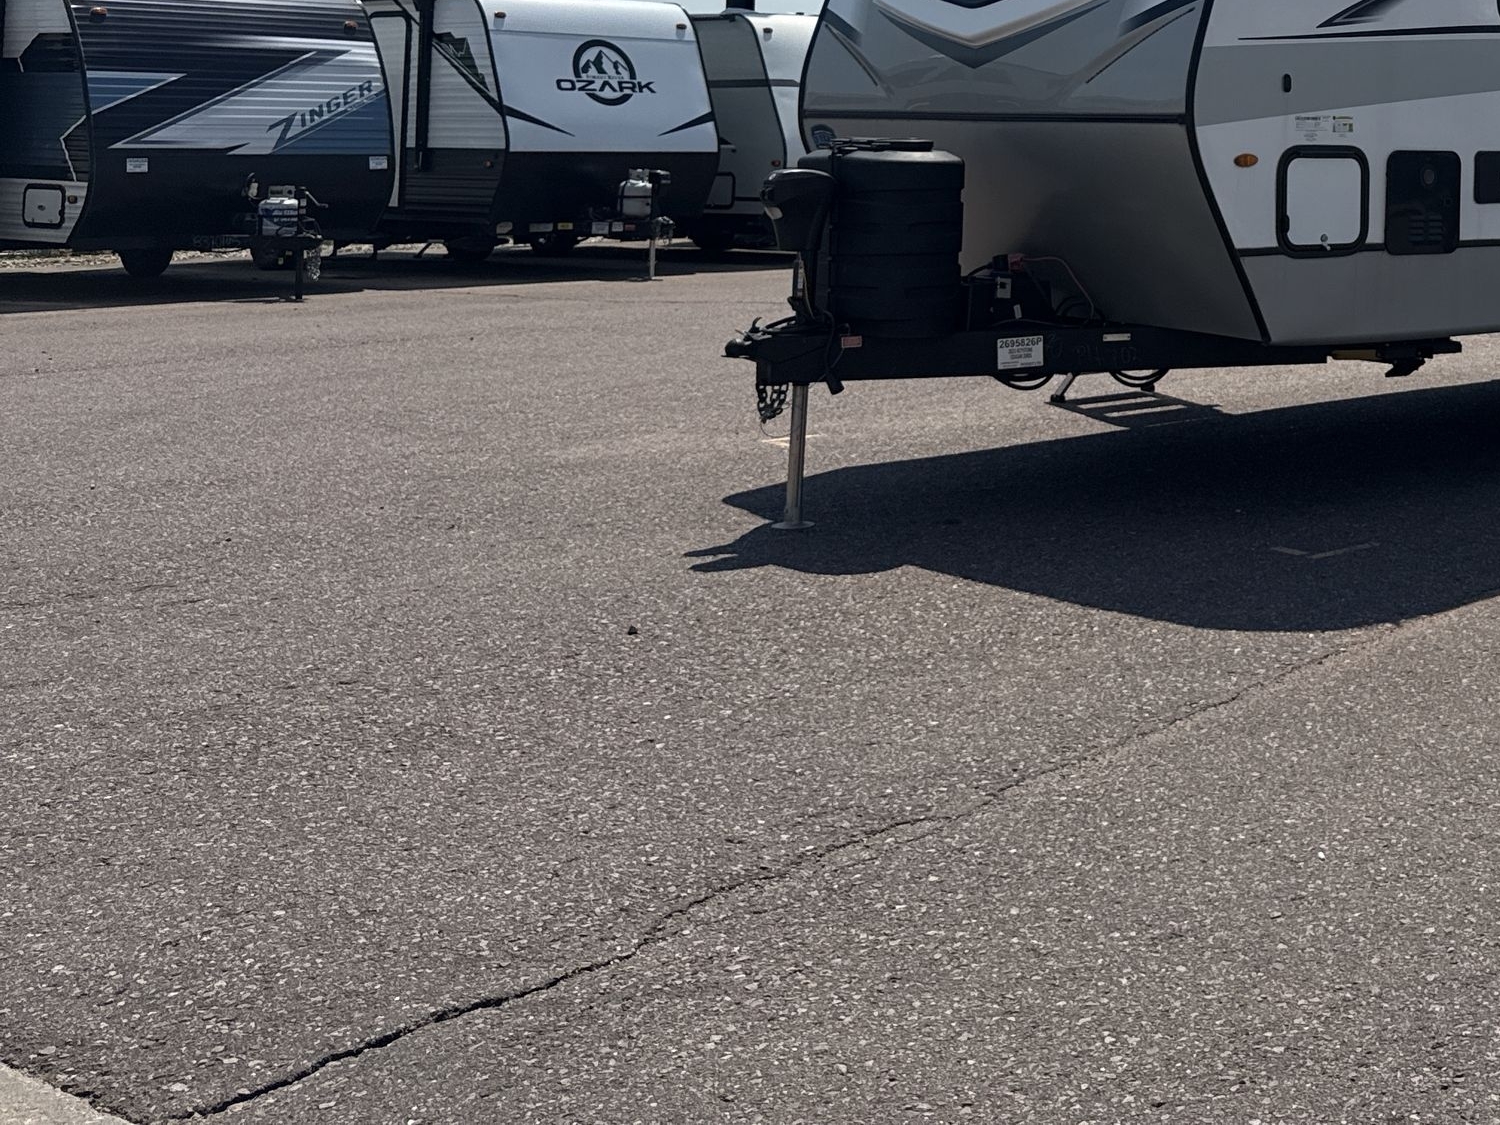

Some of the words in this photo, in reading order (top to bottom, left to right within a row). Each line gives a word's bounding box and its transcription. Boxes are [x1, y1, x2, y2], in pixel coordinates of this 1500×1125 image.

[556, 79, 656, 93] OZARK
[266, 80, 373, 150] ZINGER
[999, 337, 1042, 348] 2695826P
